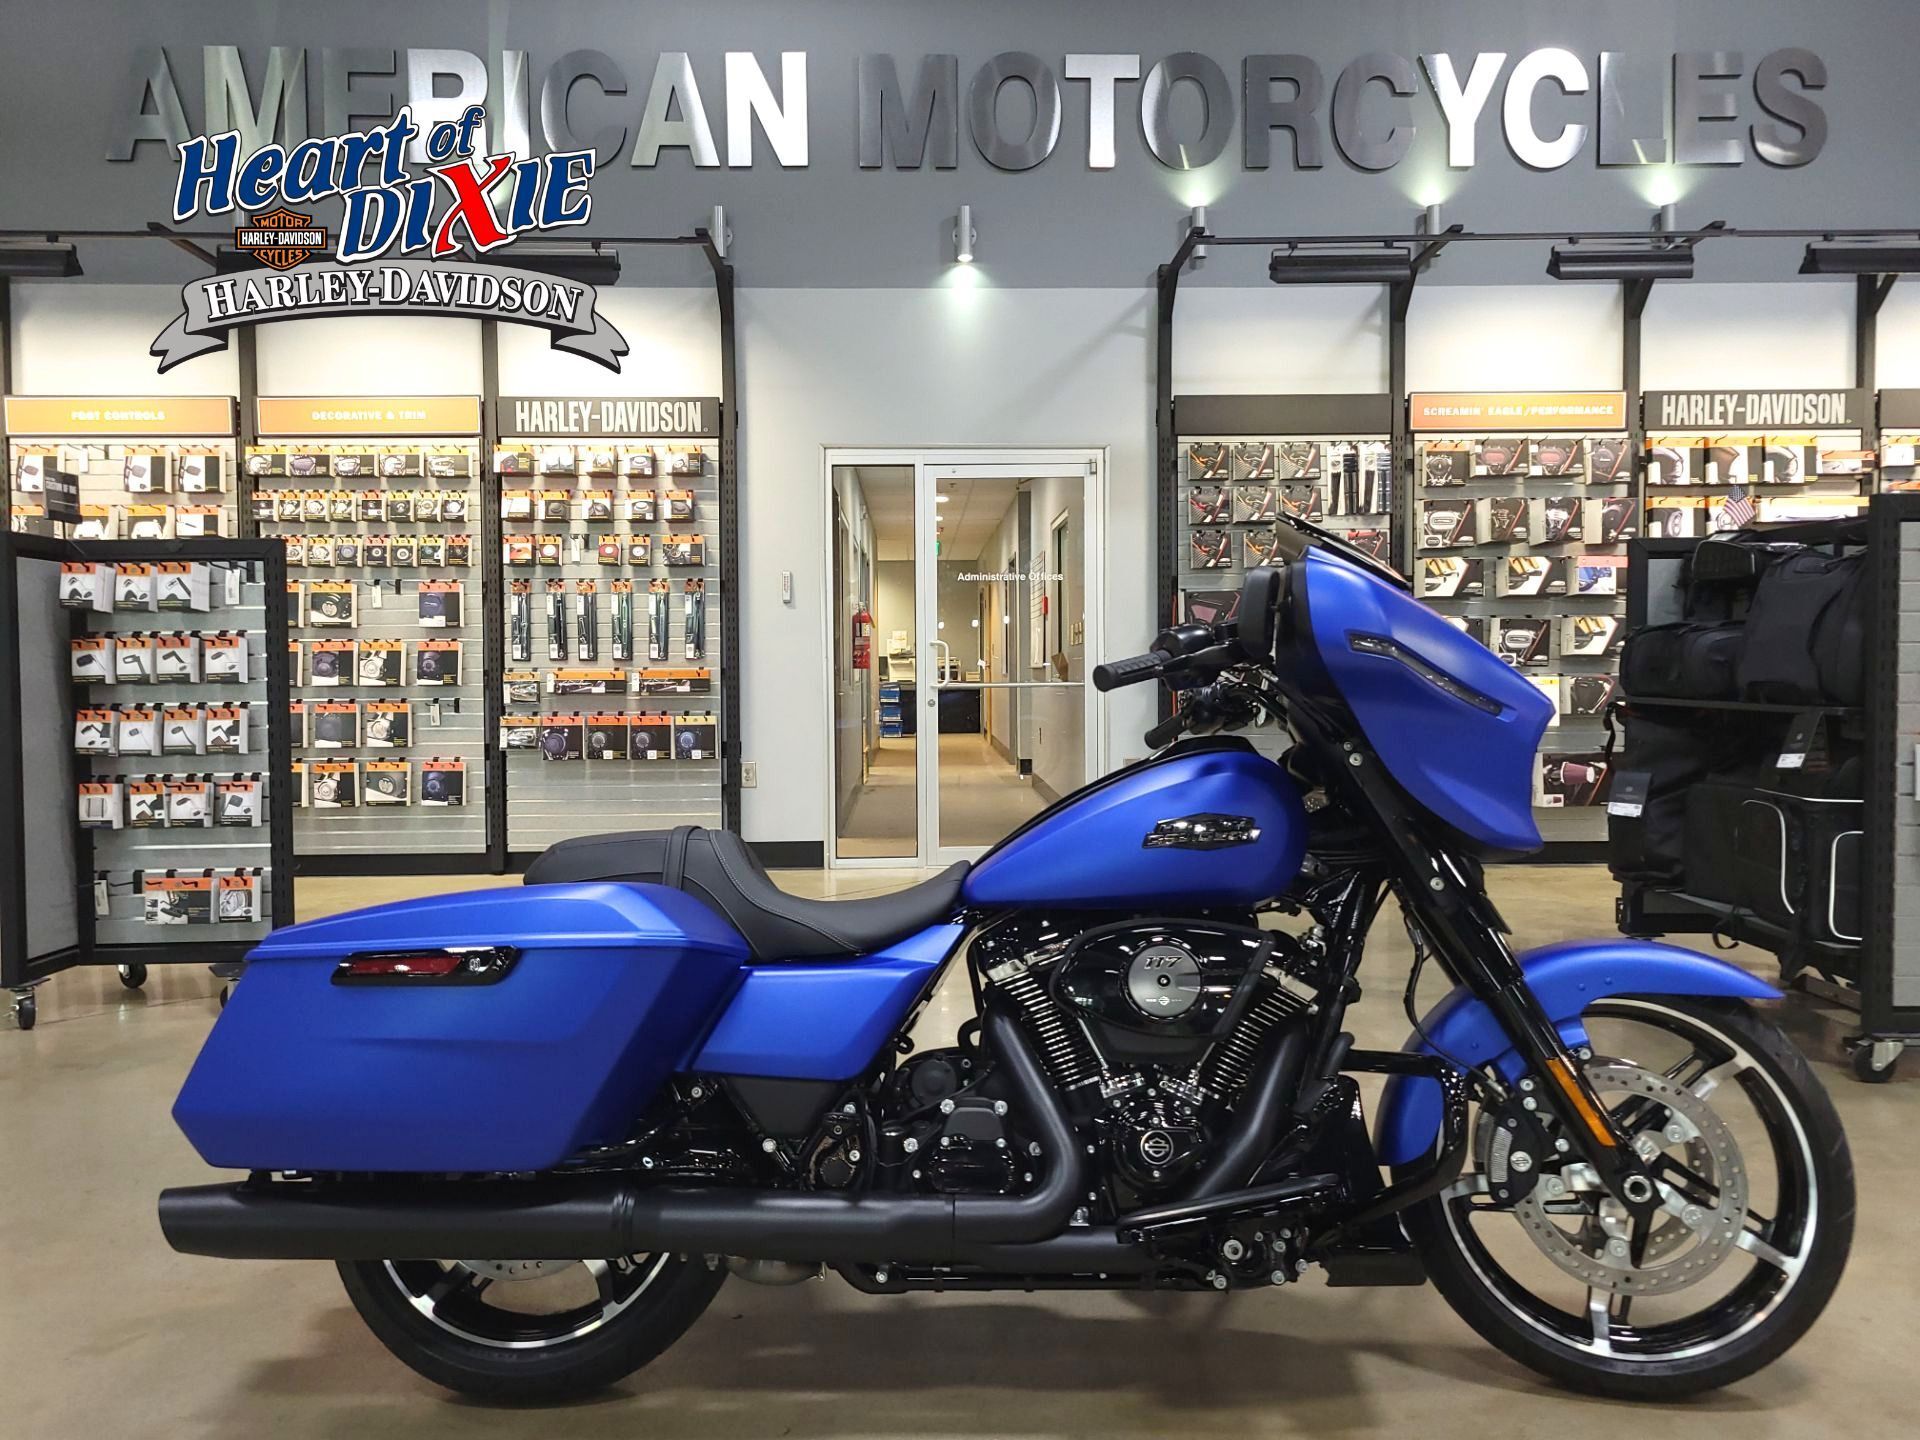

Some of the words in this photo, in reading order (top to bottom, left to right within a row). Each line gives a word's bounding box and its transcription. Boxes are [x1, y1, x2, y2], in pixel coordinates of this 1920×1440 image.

[105, 45, 810, 168] AMERICAN
[857, 47, 1829, 172] MOTORCYCLES
[103, 410, 165, 421] CONTROLS
[311, 410, 383, 421] DECORATIVE
[399, 410, 427, 421] TRIM
[515, 400, 702, 433] HARLEY-DAVIDSON
[1661, 392, 1846, 426] HARLEY-DAVIDSON
[957, 572, 1027, 582] Administrative
[1028, 572, 1065, 582] Offices
[1144, 955, 1183, 970] 117
